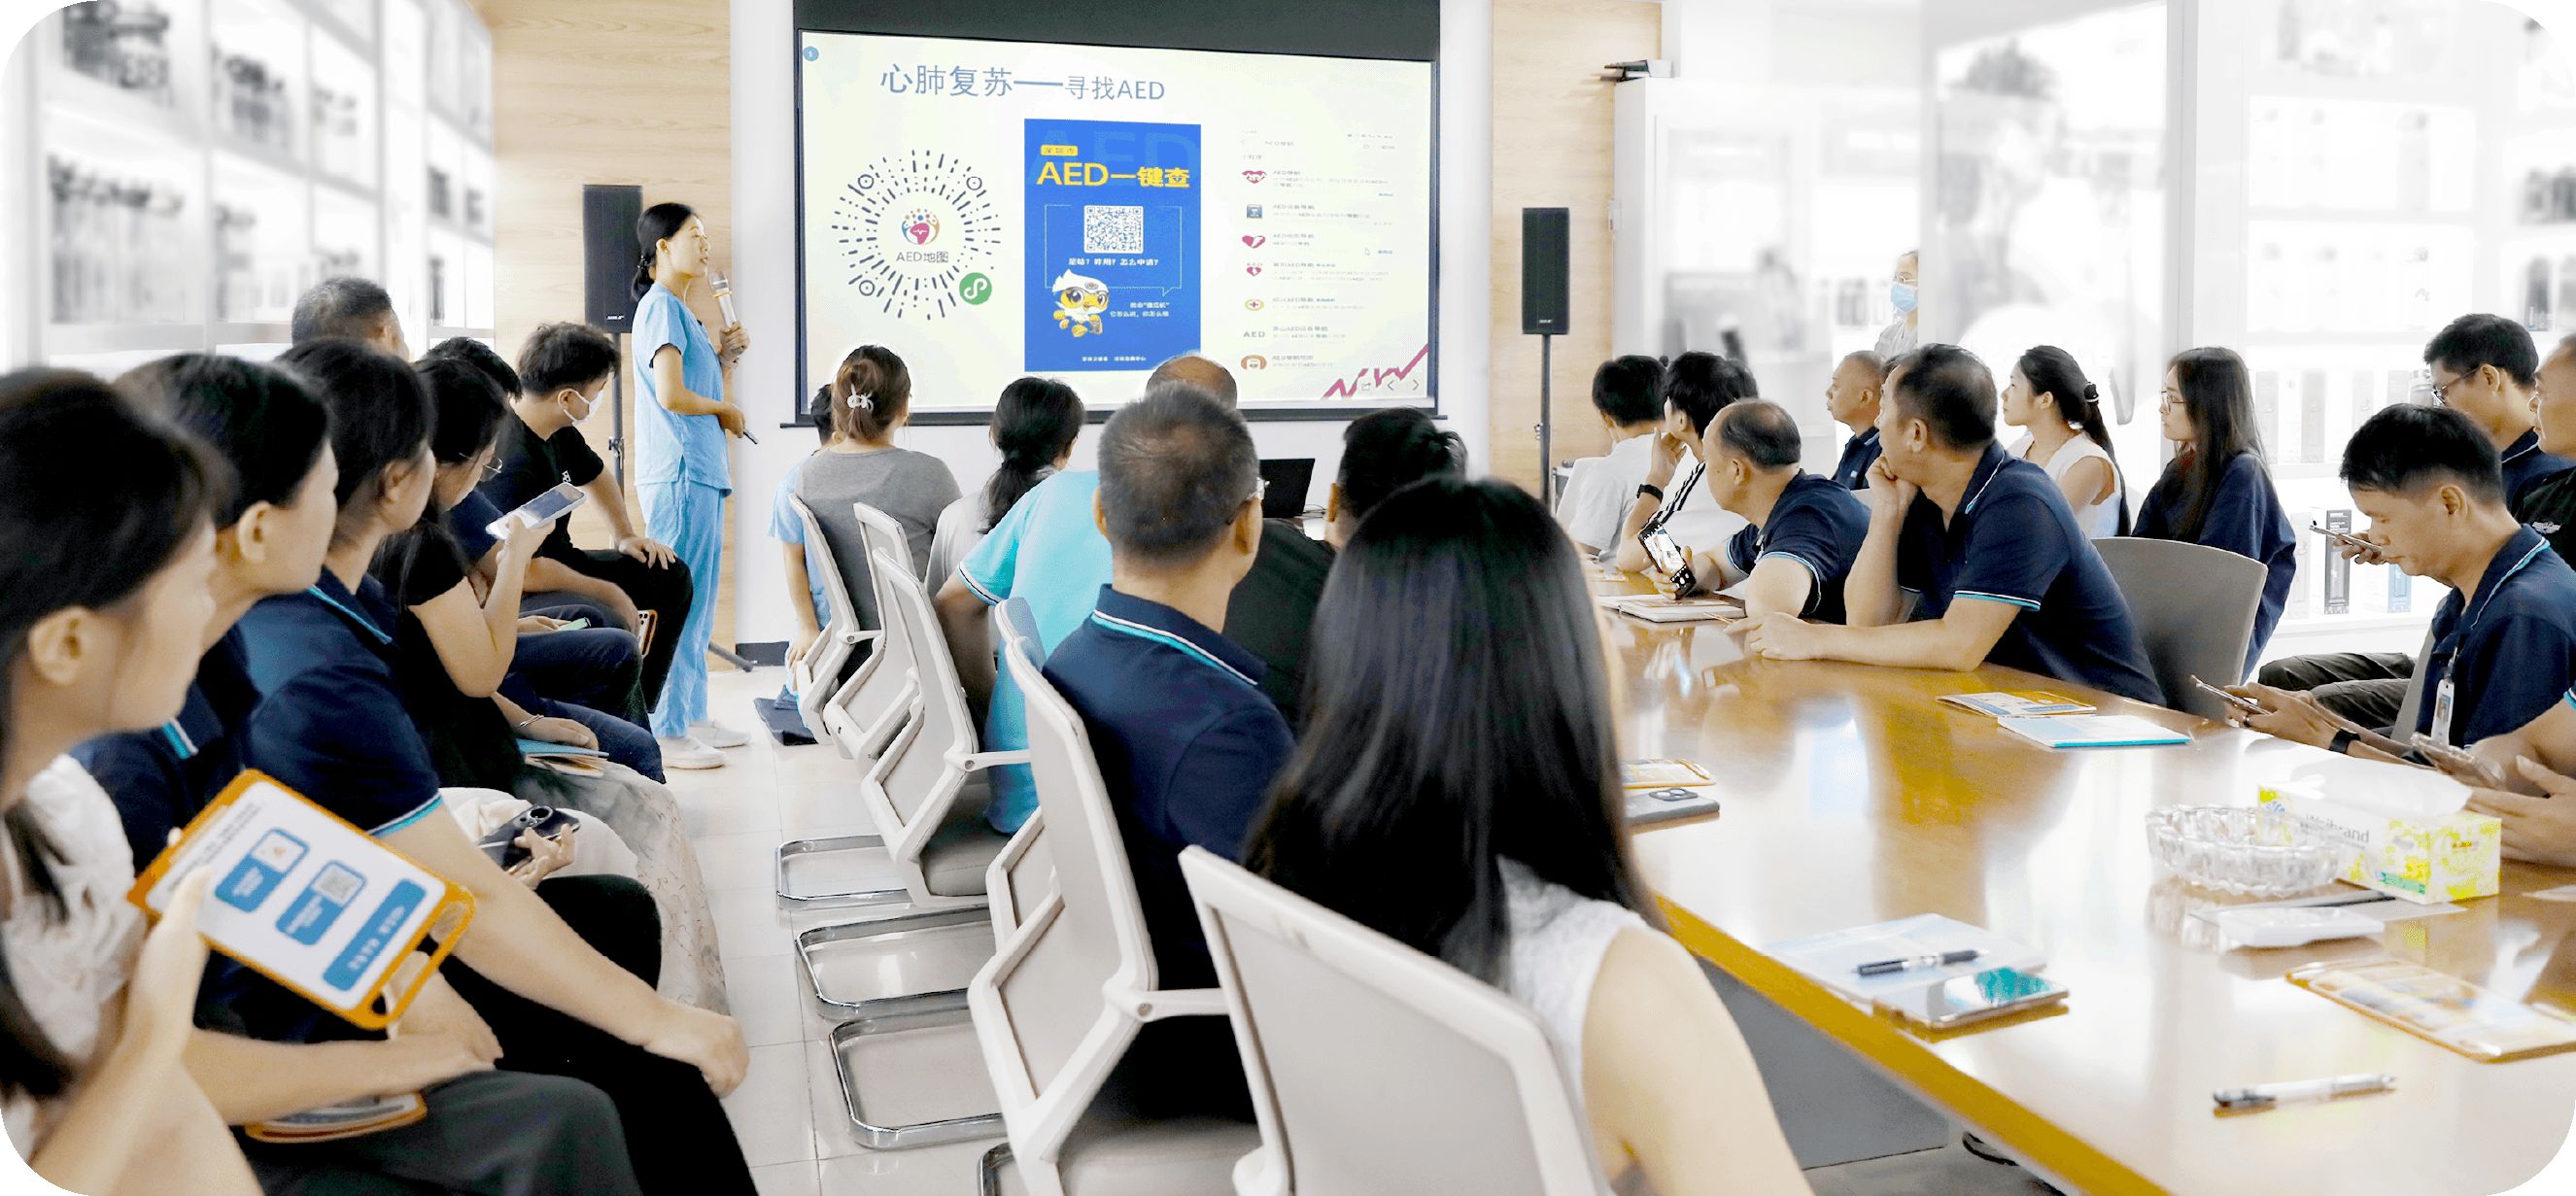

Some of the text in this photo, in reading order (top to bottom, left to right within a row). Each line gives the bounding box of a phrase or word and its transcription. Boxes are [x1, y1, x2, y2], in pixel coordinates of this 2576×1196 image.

[1036, 161, 1190, 188] AED一键查
[896, 251, 949, 263] AED地图
